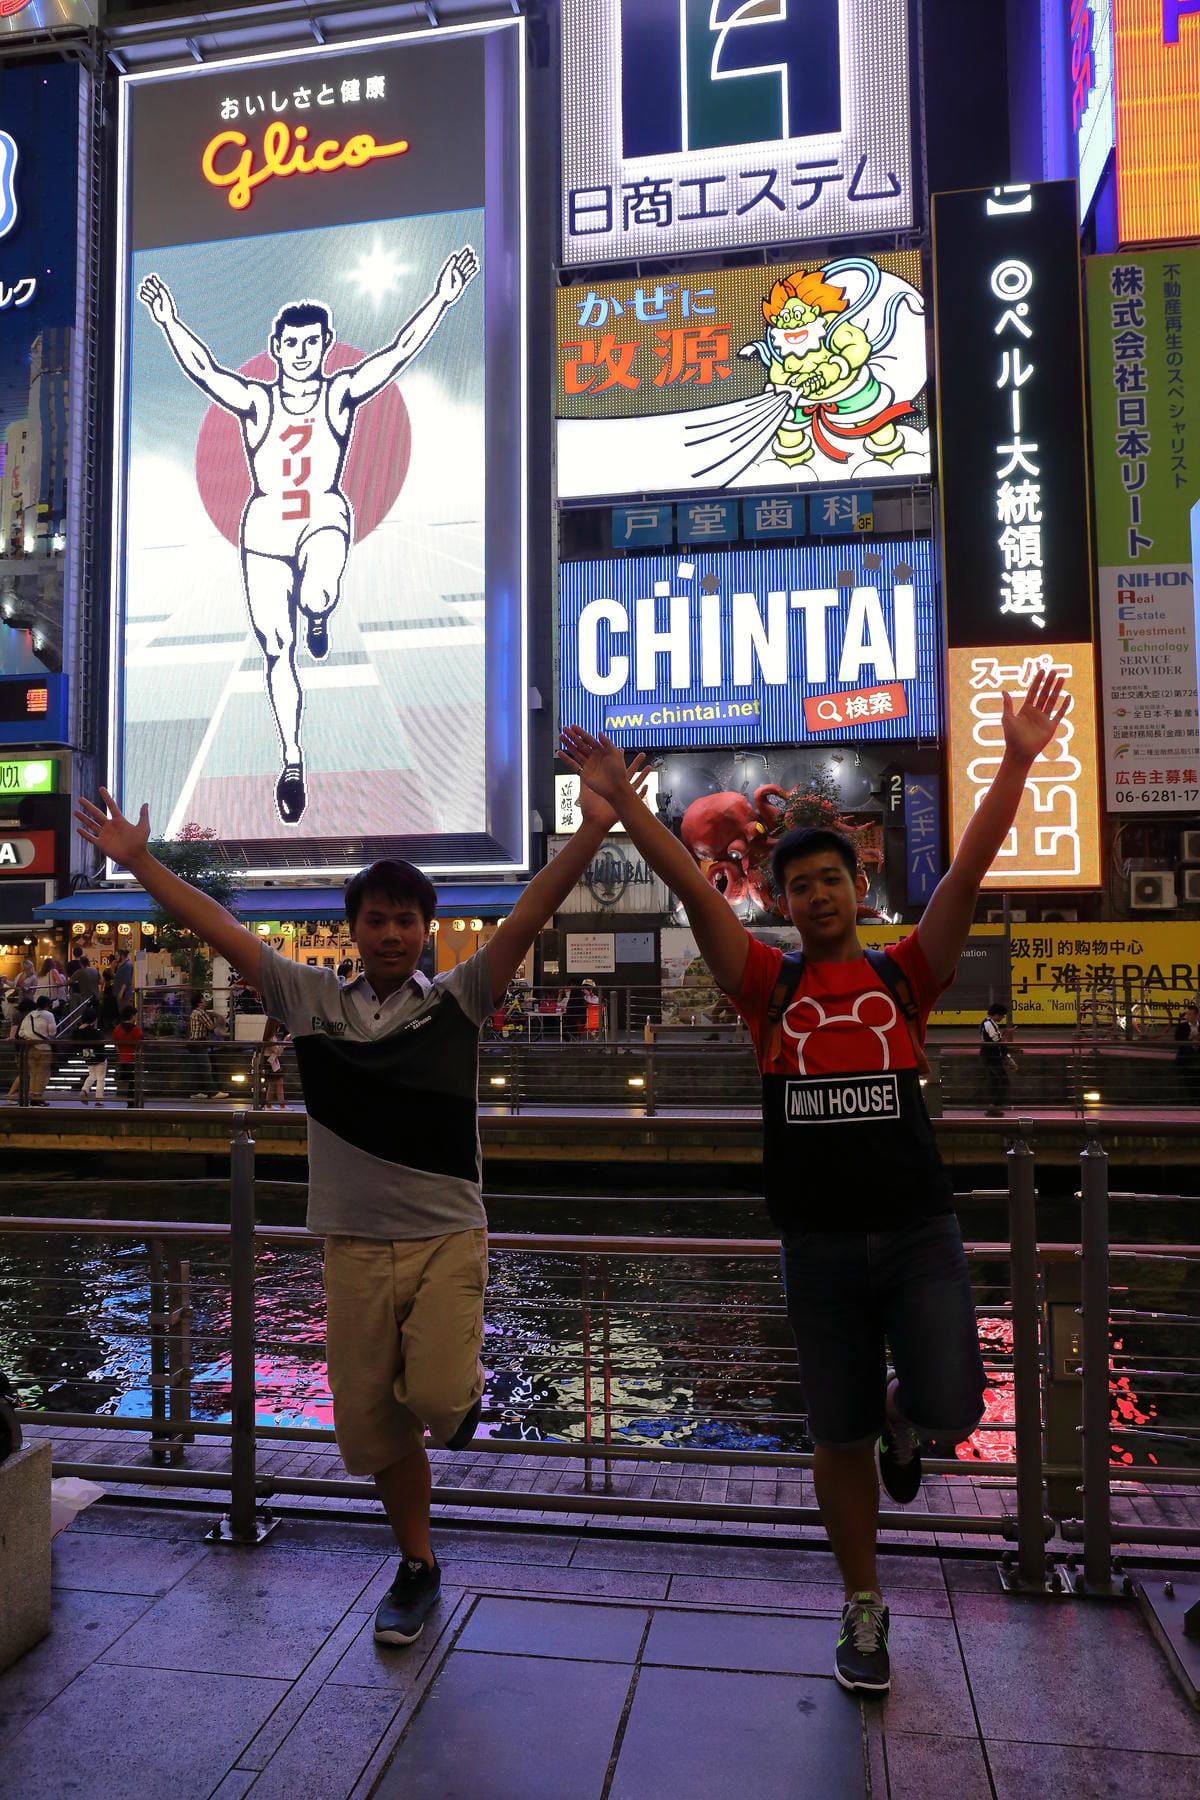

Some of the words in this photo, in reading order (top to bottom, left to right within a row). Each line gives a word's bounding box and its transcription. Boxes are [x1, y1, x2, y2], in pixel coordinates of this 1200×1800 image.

[220, 76, 386, 120] おいしさと健康
[202, 121, 409, 209] Glico
[568, 154, 902, 236] 日商エステム
[576, 282, 716, 328] かぜに
[562, 323, 734, 396] 改源
[1162, 263, 1188, 489] 不動産再生のスペシャリスト
[1110, 265, 1152, 557] 株式会社日本リート
[278, 417, 316, 521] グリコ
[624, 494, 860, 540] 戸堂歯科
[857, 517, 873, 531] 3F
[1117, 571, 1194, 588] NIHON
[1117, 589, 1155, 605] Real
[1118, 606, 1167, 621] Estate
[577, 582, 918, 696] CHINTAI
[1118, 622, 1187, 637] Investment
[1117, 637, 1190, 653] Technology
[1119, 655, 1172, 665] SERVICE
[969, 654, 1073, 688] スーパー
[1120, 665, 1182, 676] PROVIDER
[845, 691, 894, 720] 検索
[1115, 769, 1198, 785] 広告主募集
[1115, 789, 1199, 803] 06-6281-17
[0, 842, 17, 864] A
[791, 1090, 825, 1116] MINI
[829, 1085, 894, 1115] HOUSE
